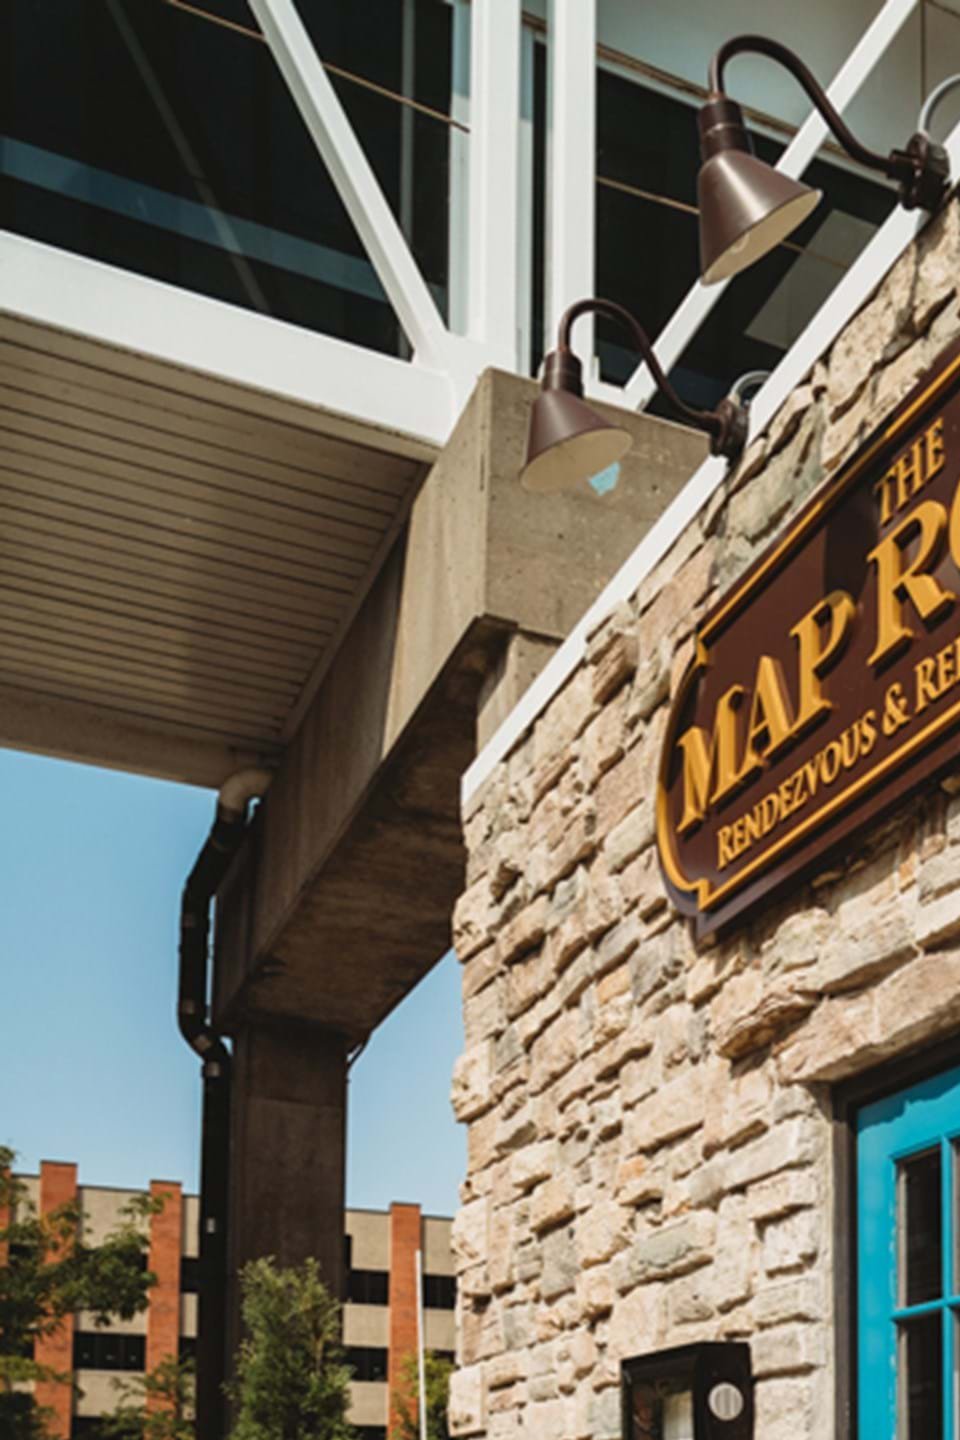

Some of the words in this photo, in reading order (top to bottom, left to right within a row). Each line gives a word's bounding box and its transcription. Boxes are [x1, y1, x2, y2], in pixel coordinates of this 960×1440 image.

[874, 417, 946, 526] THE
[674, 590, 856, 832] MAP
[716, 709, 878, 870] RENDEZVOUS
[881, 680, 909, 730] &
